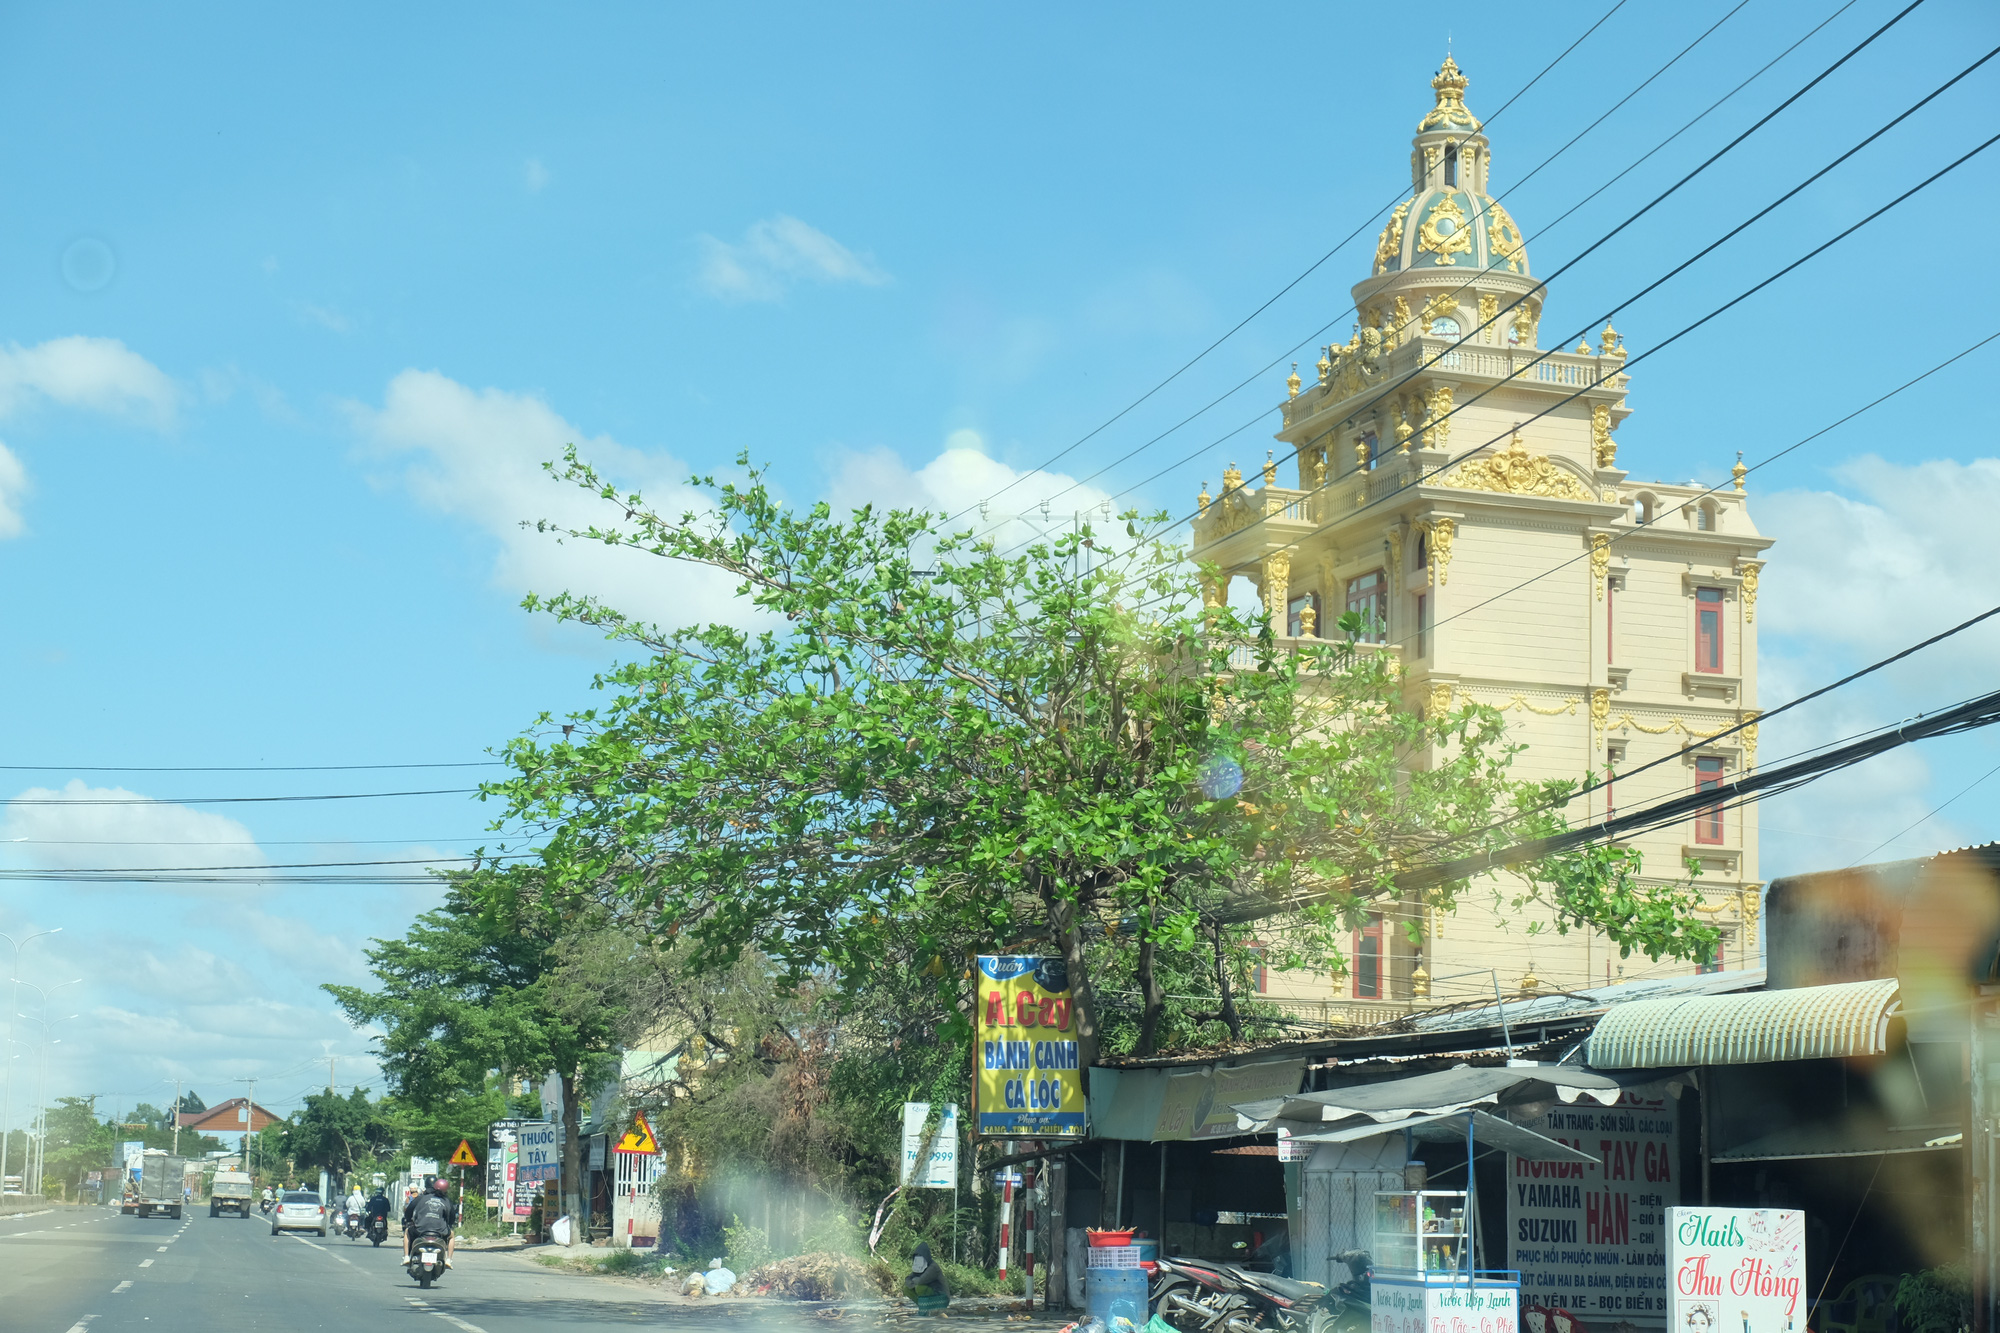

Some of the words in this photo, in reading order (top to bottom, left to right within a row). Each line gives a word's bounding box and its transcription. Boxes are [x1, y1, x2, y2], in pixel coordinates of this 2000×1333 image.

[988, 957, 1024, 976] Quán
[985, 990, 1072, 1031] A.Cay
[984, 1034, 1030, 1070] BÁNH
[1035, 1040, 1079, 1070] CANH
[1004, 1073, 1026, 1109] CÁ
[1029, 1073, 1061, 1109] LÓC
[520, 1127, 554, 1146] THUỐC
[1547, 1110, 1565, 1130] TÂN
[1566, 1114, 1594, 1131] TRANG
[1600, 1116, 1617, 1132] SƠN
[1618, 1110, 1636, 1132] SỬA
[1638, 1116, 1654, 1134] CÁC
[1655, 1120, 1673, 1138] LOẠI
[528, 1148, 548, 1164] TÂY
[1600, 1140, 1639, 1181] TAY
[1644, 1140, 1671, 1183] GA
[1517, 1183, 1582, 1209] YAMAHA
[1586, 1185, 1629, 1245] HÀN
[1517, 1217, 1577, 1243] SUZUKI
[1678, 1214, 1744, 1247] Nails
[1516, 1249, 1541, 1266] PHỤC
[1561, 1249, 1592, 1267] PHUỘC
[1594, 1249, 1619, 1265] NHÚN
[1626, 1249, 1645, 1266] LÀM
[1557, 1275, 1572, 1287] HAI
[1574, 1275, 1586, 1288] BA
[1615, 1272, 1635, 1292] ĐIỆN
[1636, 1273, 1654, 1289] ĐÈN
[1678, 1254, 1724, 1295] Thu
[1730, 1257, 1802, 1316] Hồng
[1433, 1291, 1461, 1309] Nước
[1486, 1291, 1511, 1310] Lạnh
[1543, 1292, 1568, 1308] YÊN
[1571, 1295, 1587, 1308] XE
[1599, 1296, 1622, 1312] BỌC
[1626, 1291, 1653, 1310] BIỂN
